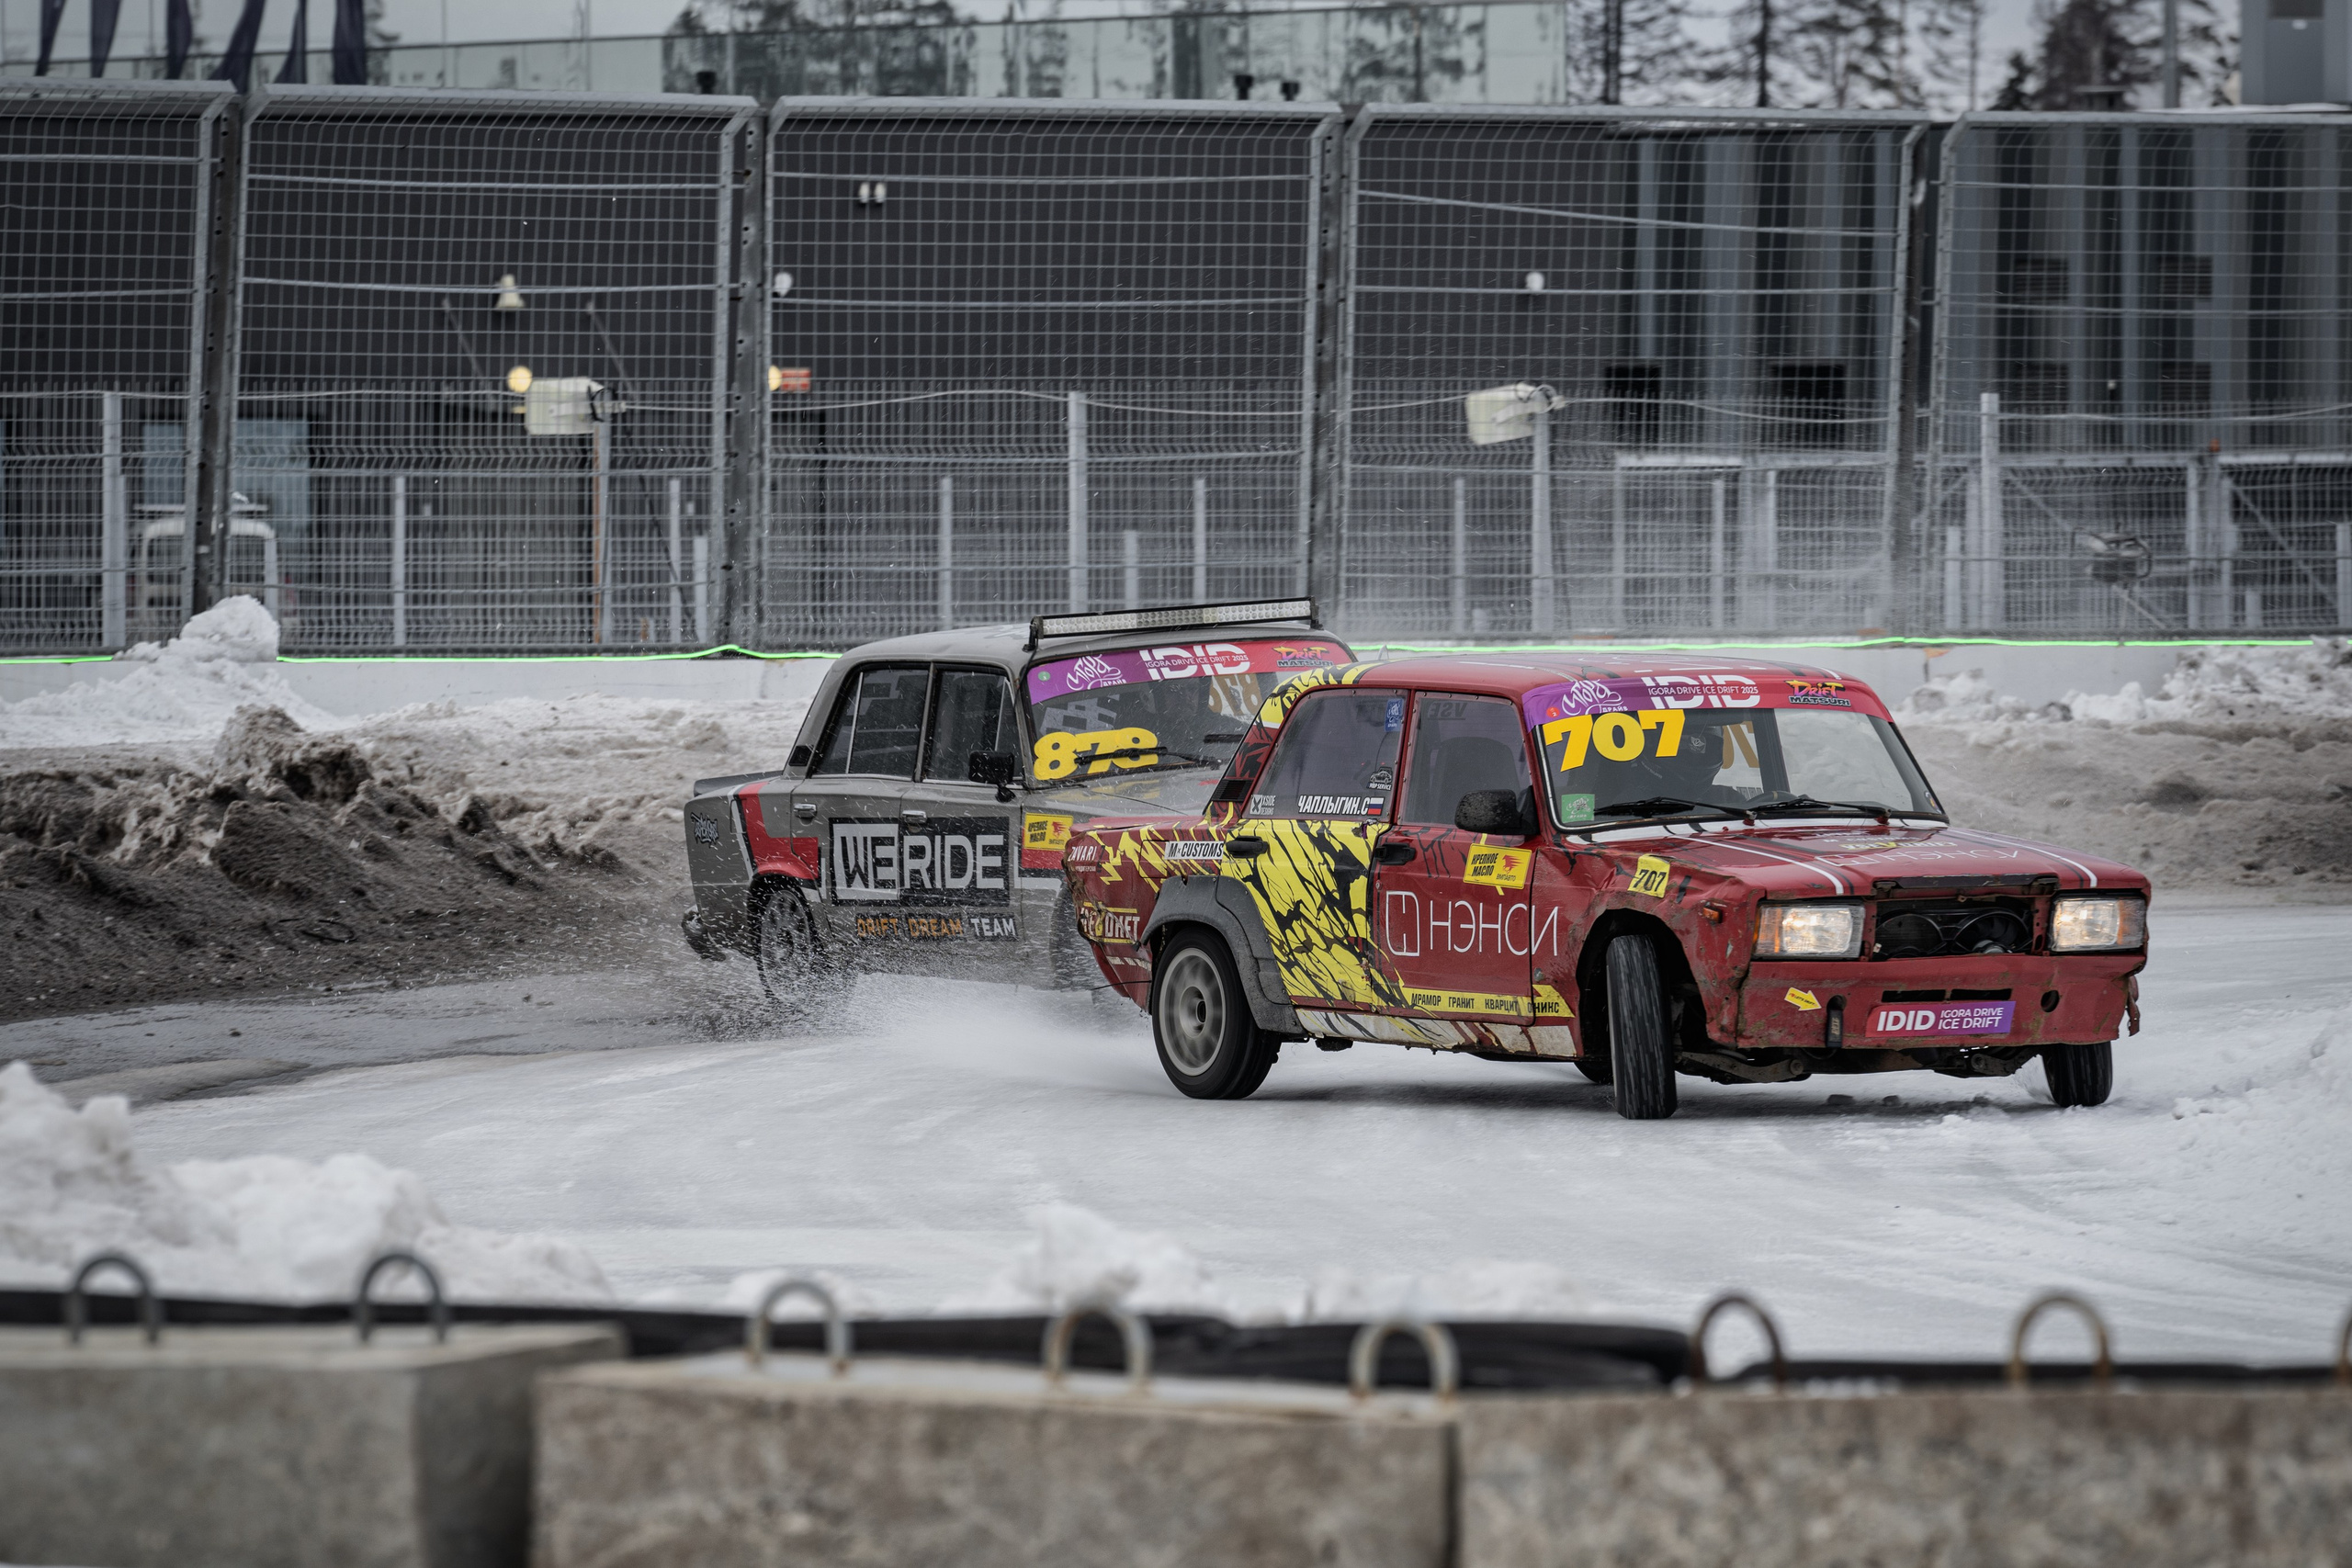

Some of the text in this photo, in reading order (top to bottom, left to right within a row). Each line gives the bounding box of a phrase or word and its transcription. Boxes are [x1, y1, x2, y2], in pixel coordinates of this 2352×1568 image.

[1139, 643, 1250, 680] IDID
[1146, 654, 1250, 669] IGORA DRIVE ICE DRIFT 2025
[1641, 674, 1760, 709] IDID
[1647, 686, 1675, 695] IGORA
[1677, 686, 1702, 694] DRIVE
[1702, 686, 1716, 694] ICE
[1789, 696, 1851, 706] MATSURI
[1543, 709, 1685, 772] 707
[1034, 728, 1159, 780] 878
[1298, 795, 1370, 815] ЧАПЛЫГИН.С
[1068, 845, 1097, 862] ZAVARI
[1471, 852, 1498, 865] КРЕПКОЕ
[1472, 864, 1494, 876] МАСЛО
[1496, 873, 1516, 882] ВМПАВТО
[1633, 869, 1667, 892] 707
[856, 918, 1016, 937] DRIFT DREAM TEAM
[1430, 900, 1559, 956] НЭНСИ
[1410, 993, 1559, 1013] МРАМОР ГРАНИТ КВАРЦИТ ОНИКС
[1877, 1007, 2004, 1032] IDID IGORA DRIVE
[1938, 1017, 2002, 1030] ICE DRIFT
